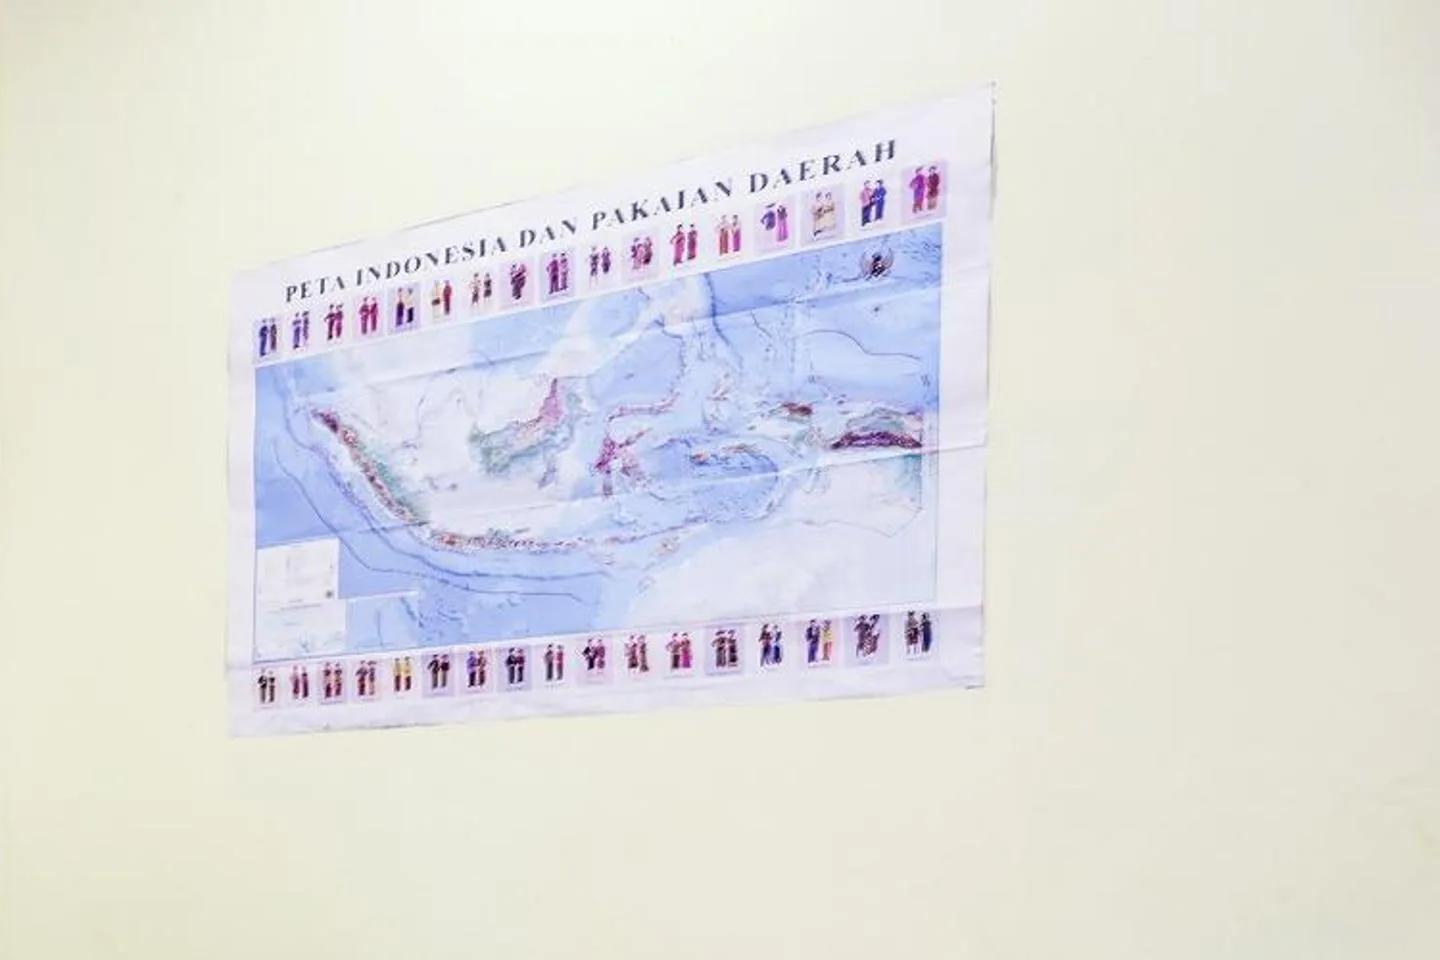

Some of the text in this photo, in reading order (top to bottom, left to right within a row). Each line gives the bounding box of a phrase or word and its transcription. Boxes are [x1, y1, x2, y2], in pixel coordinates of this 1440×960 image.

[285, 138, 897, 303] PETA INDONESIA DAN PAKAIAN DAERAH
